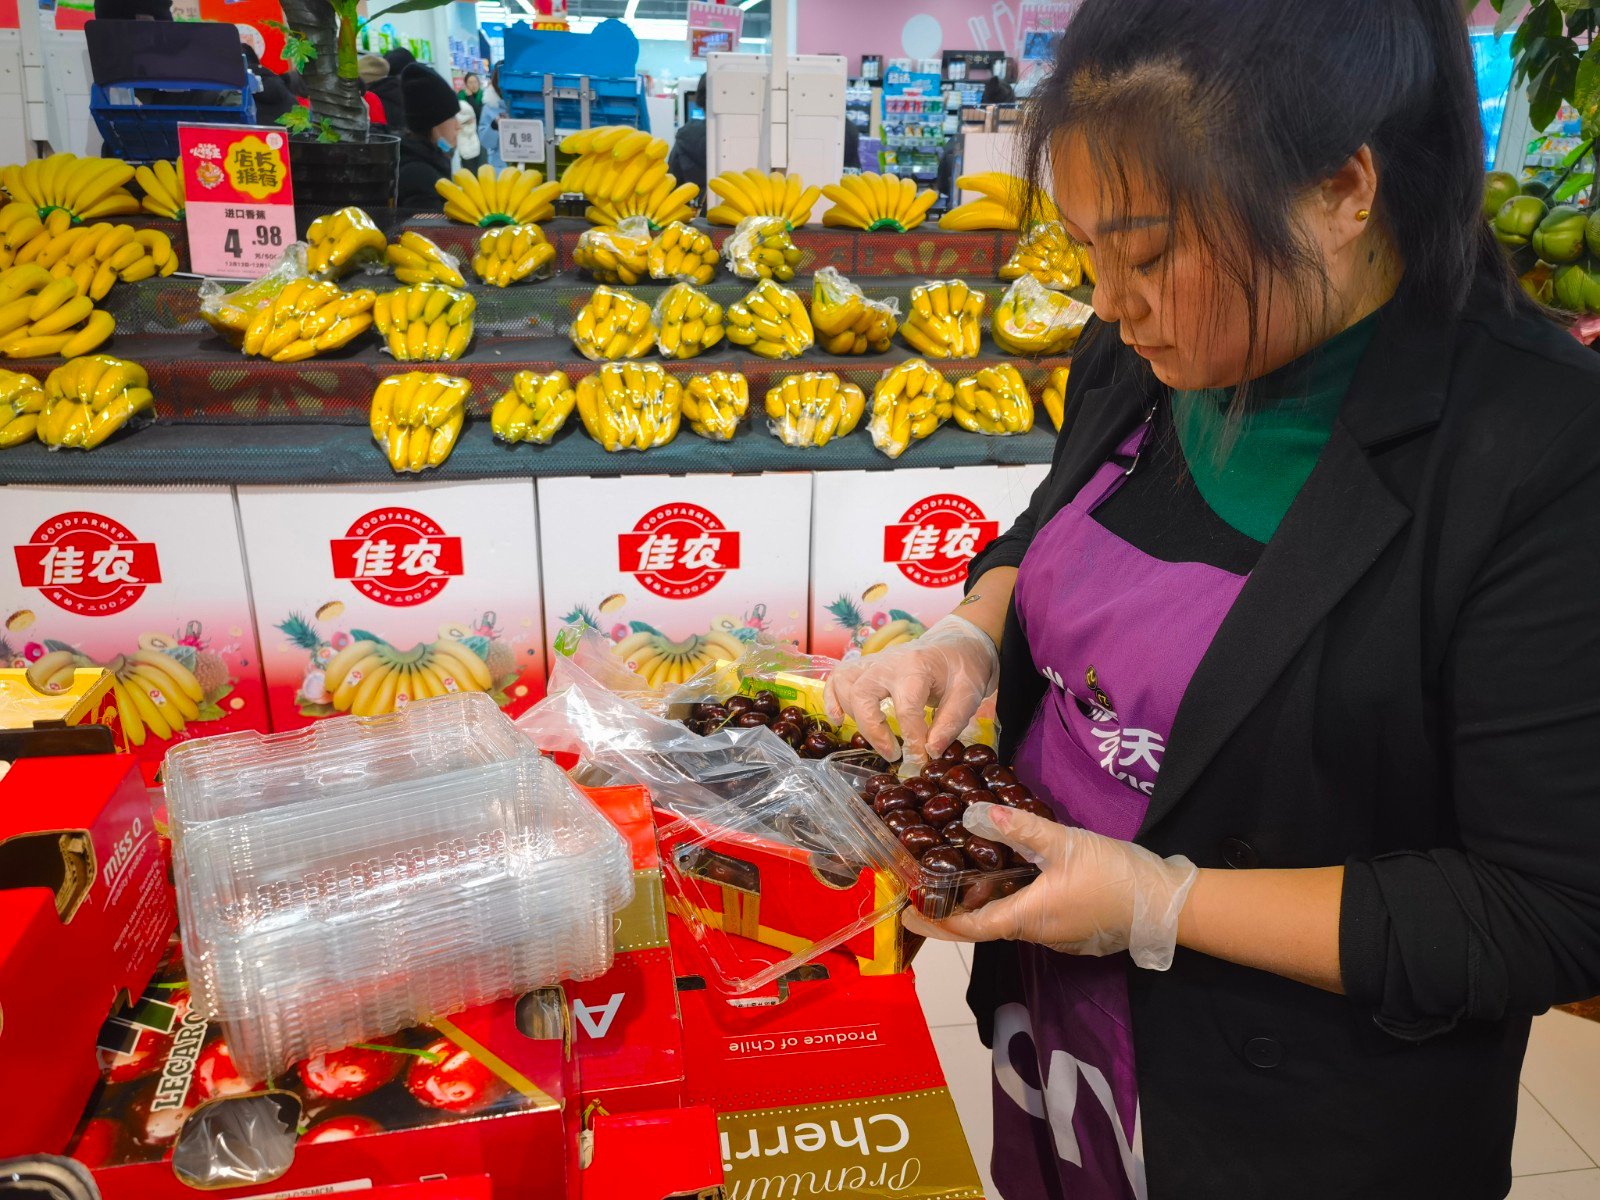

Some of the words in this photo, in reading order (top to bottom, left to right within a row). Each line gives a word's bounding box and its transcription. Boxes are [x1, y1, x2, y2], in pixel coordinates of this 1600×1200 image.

[224, 208, 266, 220] 进口香蕉
[352, 539, 445, 577] 佳农
[637, 533, 721, 571] 佳农
[901, 523, 981, 561] 佳农
[39, 544, 140, 585] 佳农
[103, 829, 133, 887] miss
[574, 992, 626, 1039] A
[729, 1039, 776, 1053] Chile
[779, 1036, 798, 1050] of
[804, 1030, 878, 1046] Produce
